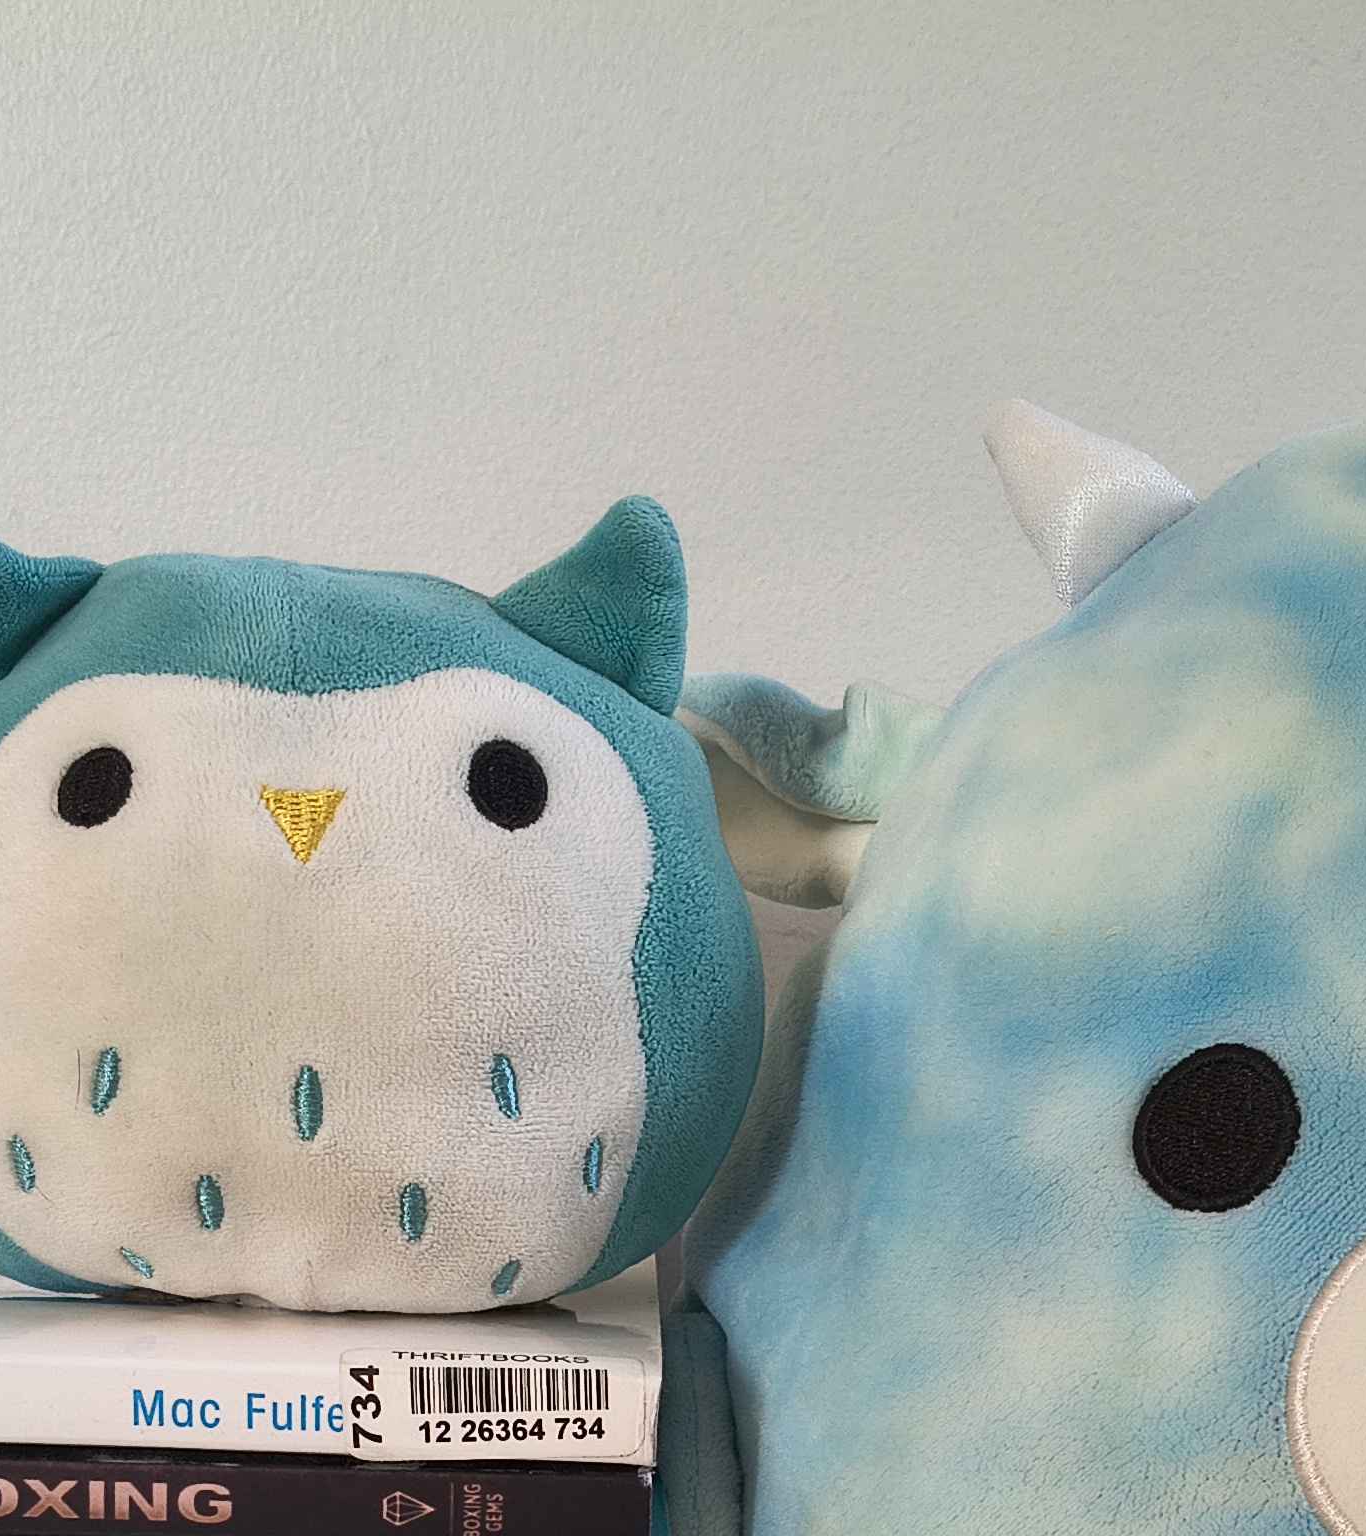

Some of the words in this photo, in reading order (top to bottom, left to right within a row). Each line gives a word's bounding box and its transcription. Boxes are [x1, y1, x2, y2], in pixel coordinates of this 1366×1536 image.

[393, 1352, 588, 1363] THRIFTBOOKS
[133, 1390, 220, 1428] Mac
[350, 1365, 382, 1448] 734
[419, 1421, 451, 1443] 12
[461, 1419, 545, 1442] 26364
[555, 1417, 605, 1439] 734
[485, 1494, 503, 1531] GEMS
